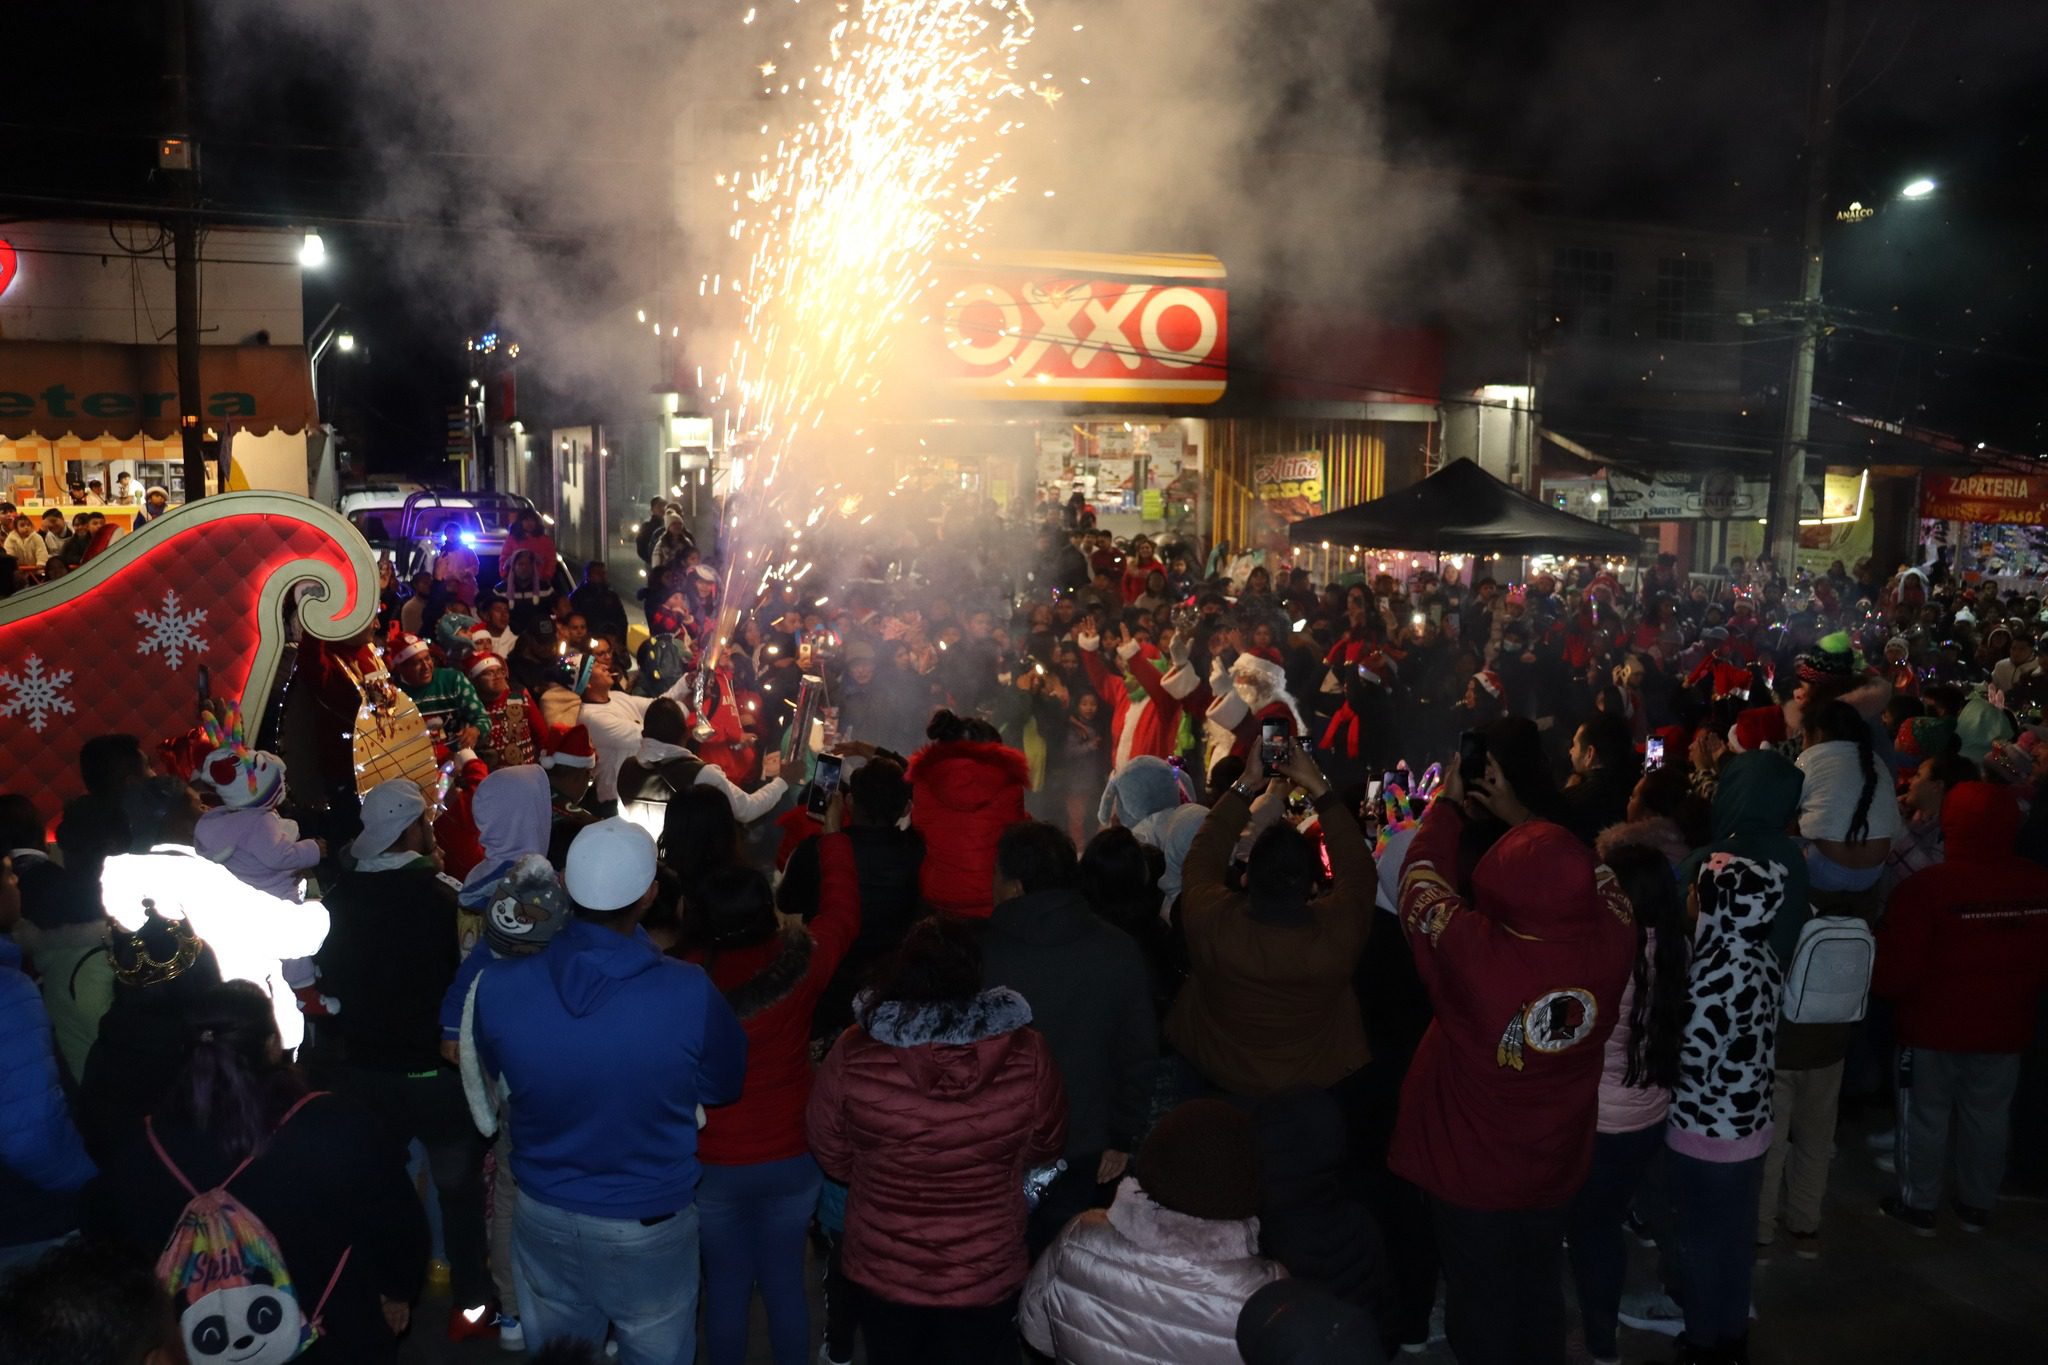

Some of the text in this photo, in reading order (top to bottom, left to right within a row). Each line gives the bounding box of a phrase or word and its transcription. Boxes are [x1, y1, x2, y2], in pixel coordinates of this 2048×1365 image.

[944, 280, 1218, 378] OXXO
[0, 384, 256, 417] etera
[1255, 455, 1317, 483] Alitas
[1949, 477, 2028, 498] ZAPATERIA
